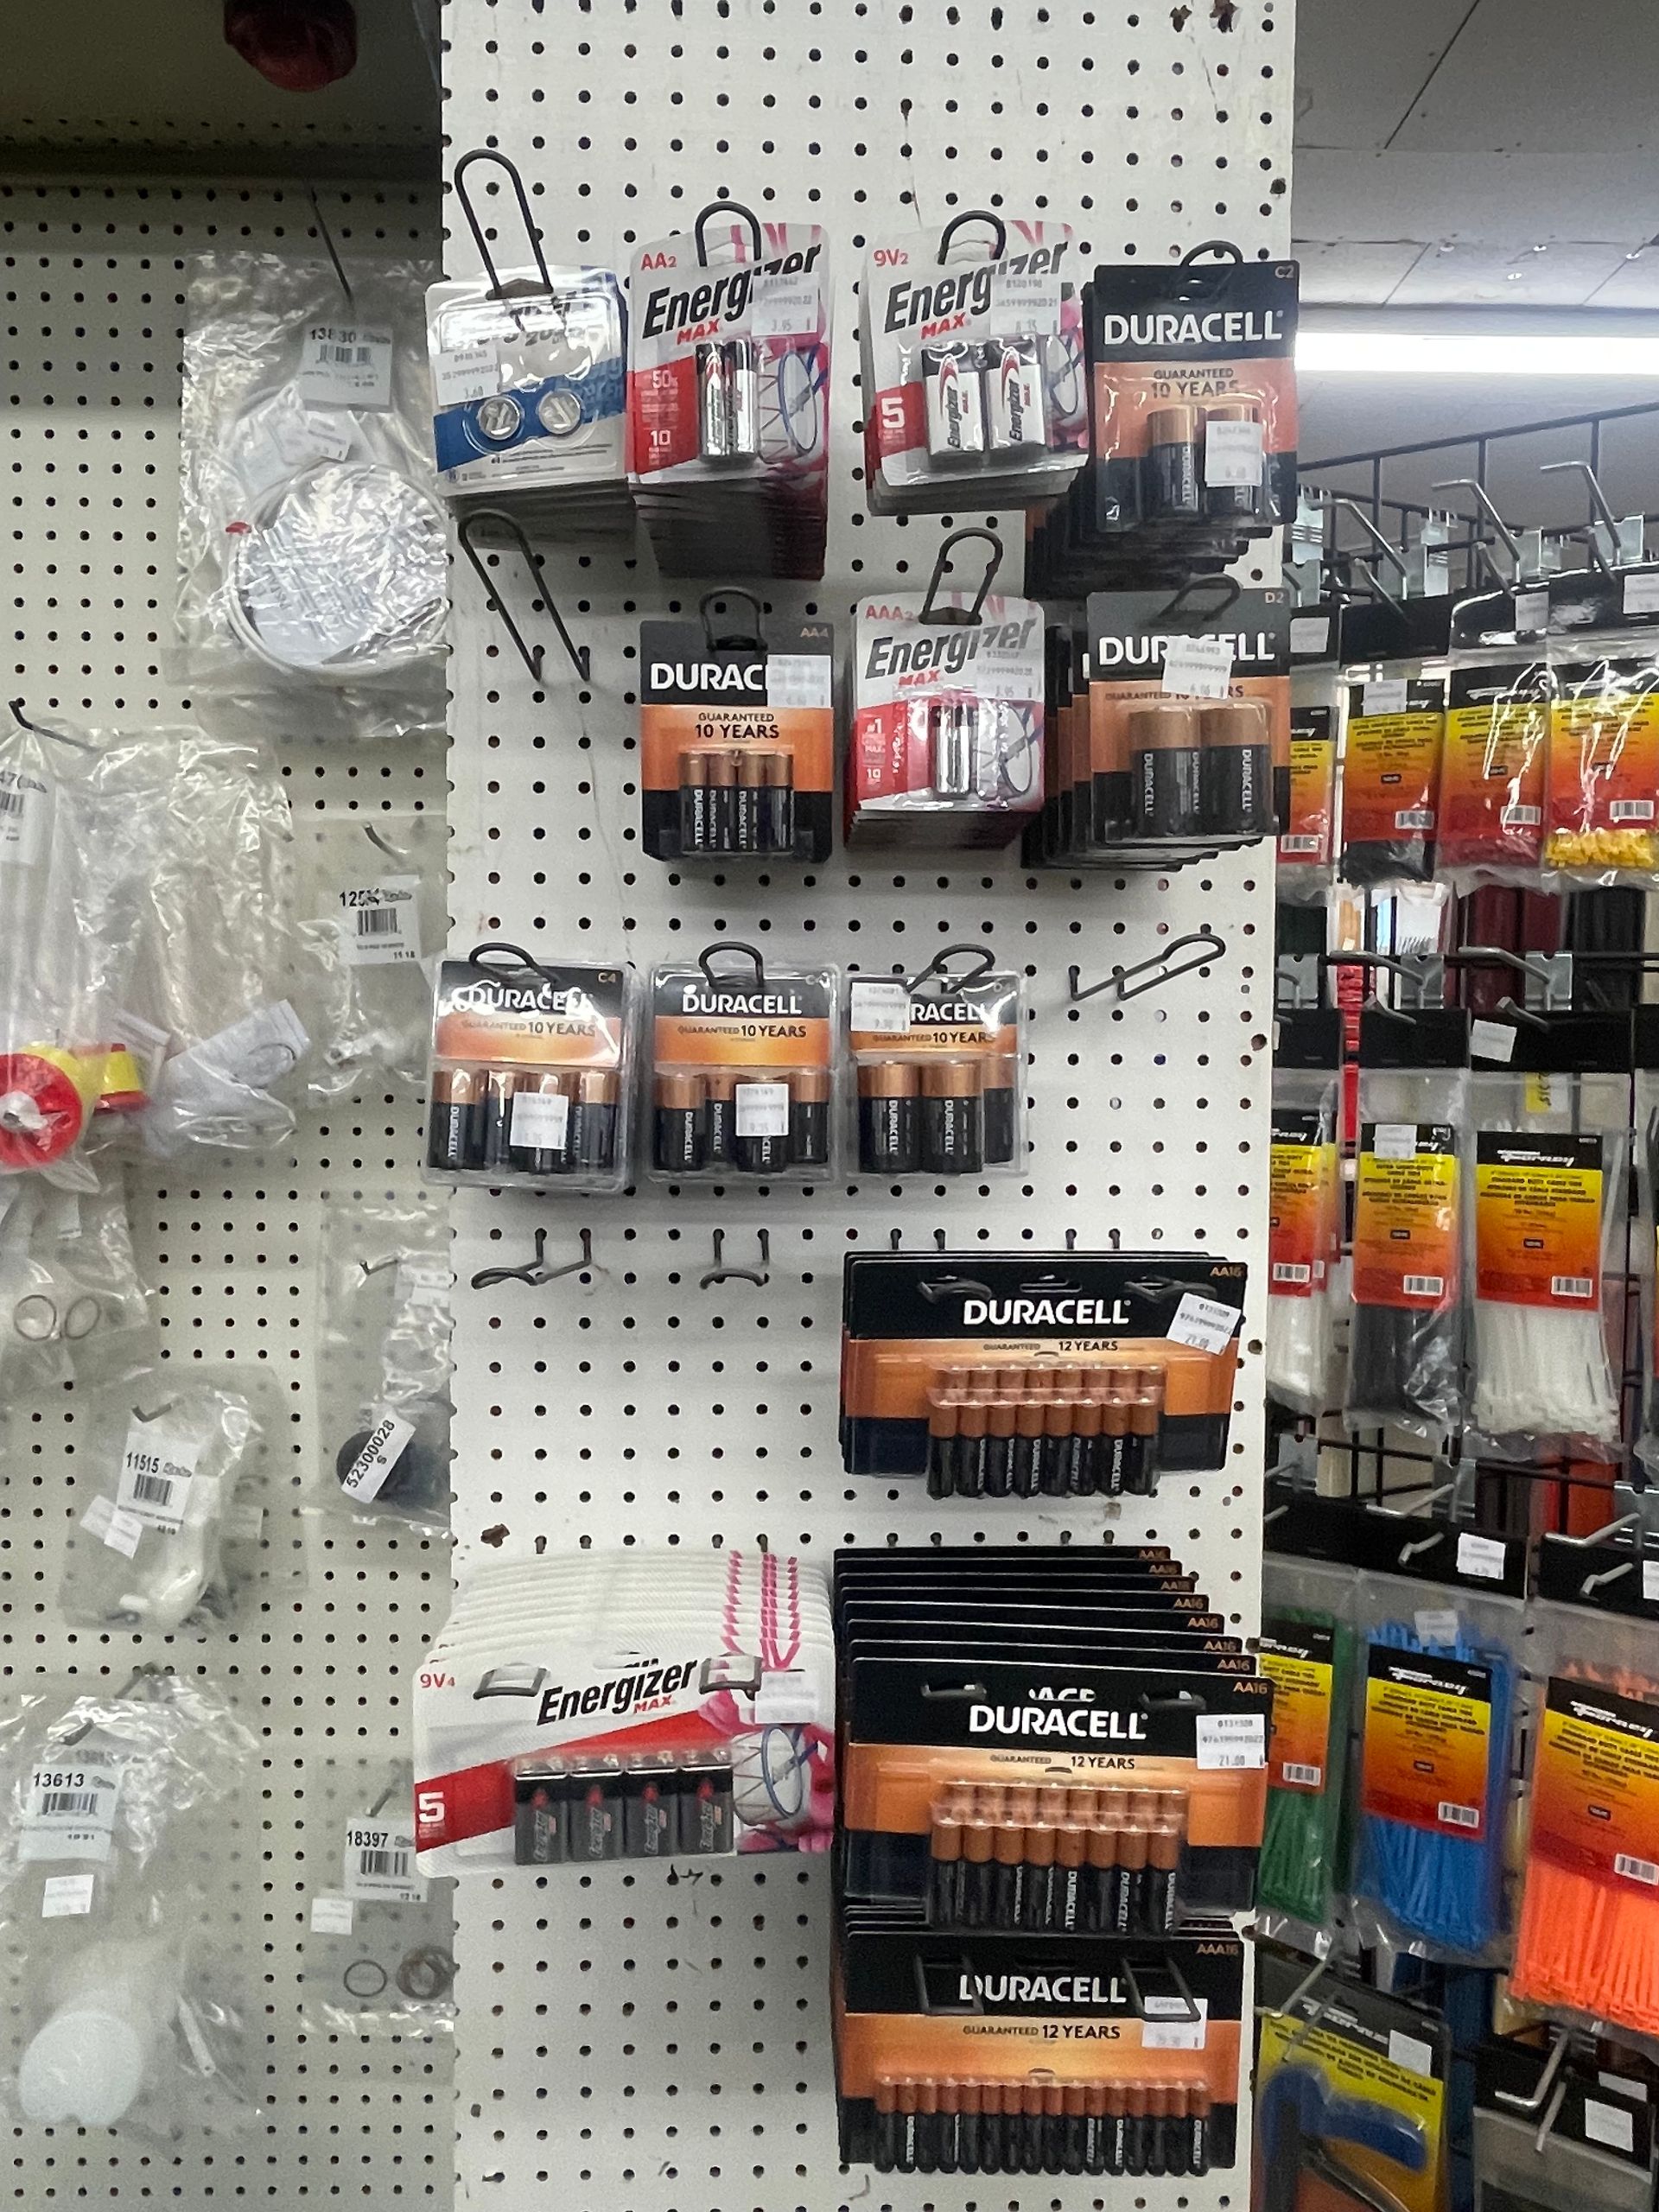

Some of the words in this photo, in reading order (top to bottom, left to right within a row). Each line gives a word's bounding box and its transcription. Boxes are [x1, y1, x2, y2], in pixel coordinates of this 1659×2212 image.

[639, 251, 677, 271] AA2
[873, 248, 909, 267] 9V2
[641, 244, 821, 340] Energer
[883, 241, 1069, 334] Energzer
[677, 318, 721, 345] MAX
[920, 312, 966, 340] MAX
[1103, 310, 1282, 346] DURACELL
[1153, 367, 1235, 380] GUARANTEED
[1151, 383, 1171, 398] 10
[1176, 380, 1239, 397] YEARS
[880, 397, 906, 429] 5
[1265, 592, 1285, 604] D2
[866, 604, 914, 621] AAA2
[865, 618, 1037, 680] Energizer
[1099, 632, 1276, 667] DURLL
[651, 663, 768, 691] DURAC
[898, 670, 942, 688] MAX
[698, 713, 774, 723] GUARANTEED
[695, 724, 715, 739] 10
[720, 724, 780, 741] YEARS
[1144, 753, 1154, 815] DURACELL
[598, 971, 617, 983] C4
[683, 994, 803, 1015] DURACELL
[912, 1002, 985, 1022] RACEL
[528, 1021, 544, 1035] 10
[546, 1021, 596, 1037] YEARS
[677, 1026, 739, 1035] GUARANTEED
[741, 1026, 756, 1037] 10
[759, 1026, 807, 1038] YEARS
[933, 1032, 947, 1043] 10
[963, 1299, 1128, 1326] DURACELL
[982, 1343, 1041, 1351] GUARANTEED
[1058, 1341, 1071, 1352] 12
[1074, 1340, 1119, 1352] YEARS
[127, 1452, 160, 1474] 11515
[346, 1420, 395, 1488] 52300028
[1173, 1599, 1204, 1610] AA16
[1187, 1617, 1218, 1629] AA16
[1217, 1659, 1250, 1671] AA16
[419, 1673, 456, 1689] 9V4
[1233, 1681, 1268, 1695] AA16
[537, 1659, 698, 1726] Energizer
[632, 1694, 672, 1715] MAX
[969, 1705, 1146, 1741] DURACELL
[989, 1754, 1052, 1765] GUARANTEED
[1071, 1755, 1085, 1769] 12
[1088, 1755, 1136, 1770] YEARS
[34, 1772, 85, 1788] 13613
[417, 1791, 445, 1824] 5
[346, 1830, 389, 1848] 18397
[959, 1974, 1127, 2003] DURACELL
[963, 2024, 1039, 2037] GUARANTEED
[1042, 2024, 1058, 2039] 12
[1063, 2024, 1121, 2040] YEARS
